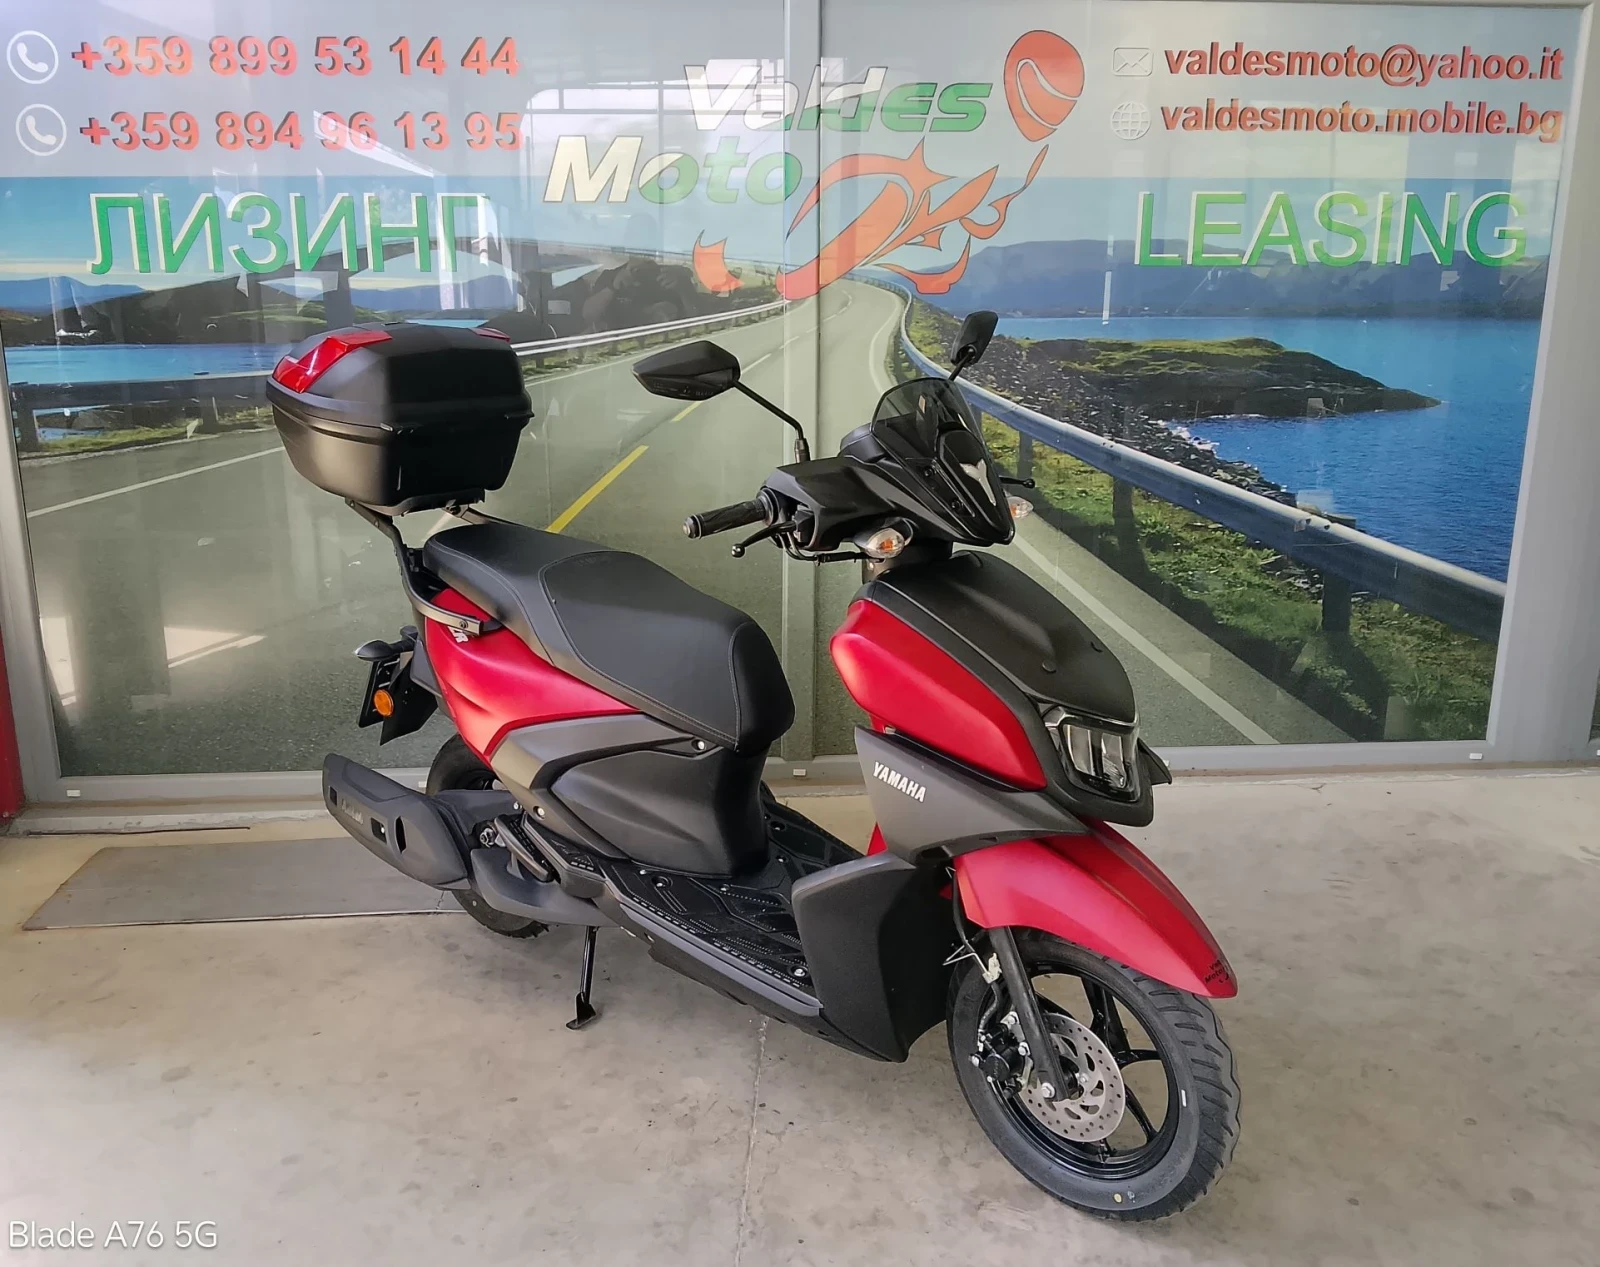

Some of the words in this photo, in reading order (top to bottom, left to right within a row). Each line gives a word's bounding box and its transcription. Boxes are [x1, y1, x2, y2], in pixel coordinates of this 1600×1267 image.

[71, 35, 193, 76] +359
[208, 35, 299, 76] 899
[313, 35, 373, 77] 53
[389, 36, 447, 76] 14
[460, 36, 521, 76] 44
[1164, 41, 1565, 87] valdesmoto@yahoo.it
[683, 64, 993, 132] Valdes
[1160, 98, 1564, 143] valdesmoto.mobile.bg
[80, 111, 200, 151] +359
[215, 111, 304, 151] 894
[319, 111, 379, 152] 96
[394, 111, 451, 151] 13
[465, 111, 524, 151] 95
[543, 135, 803, 205] Moto
[86, 191, 491, 276] ЛИЗИНГ
[1134, 191, 1527, 268] LEASING
[873, 761, 927, 803] YAMAHA
